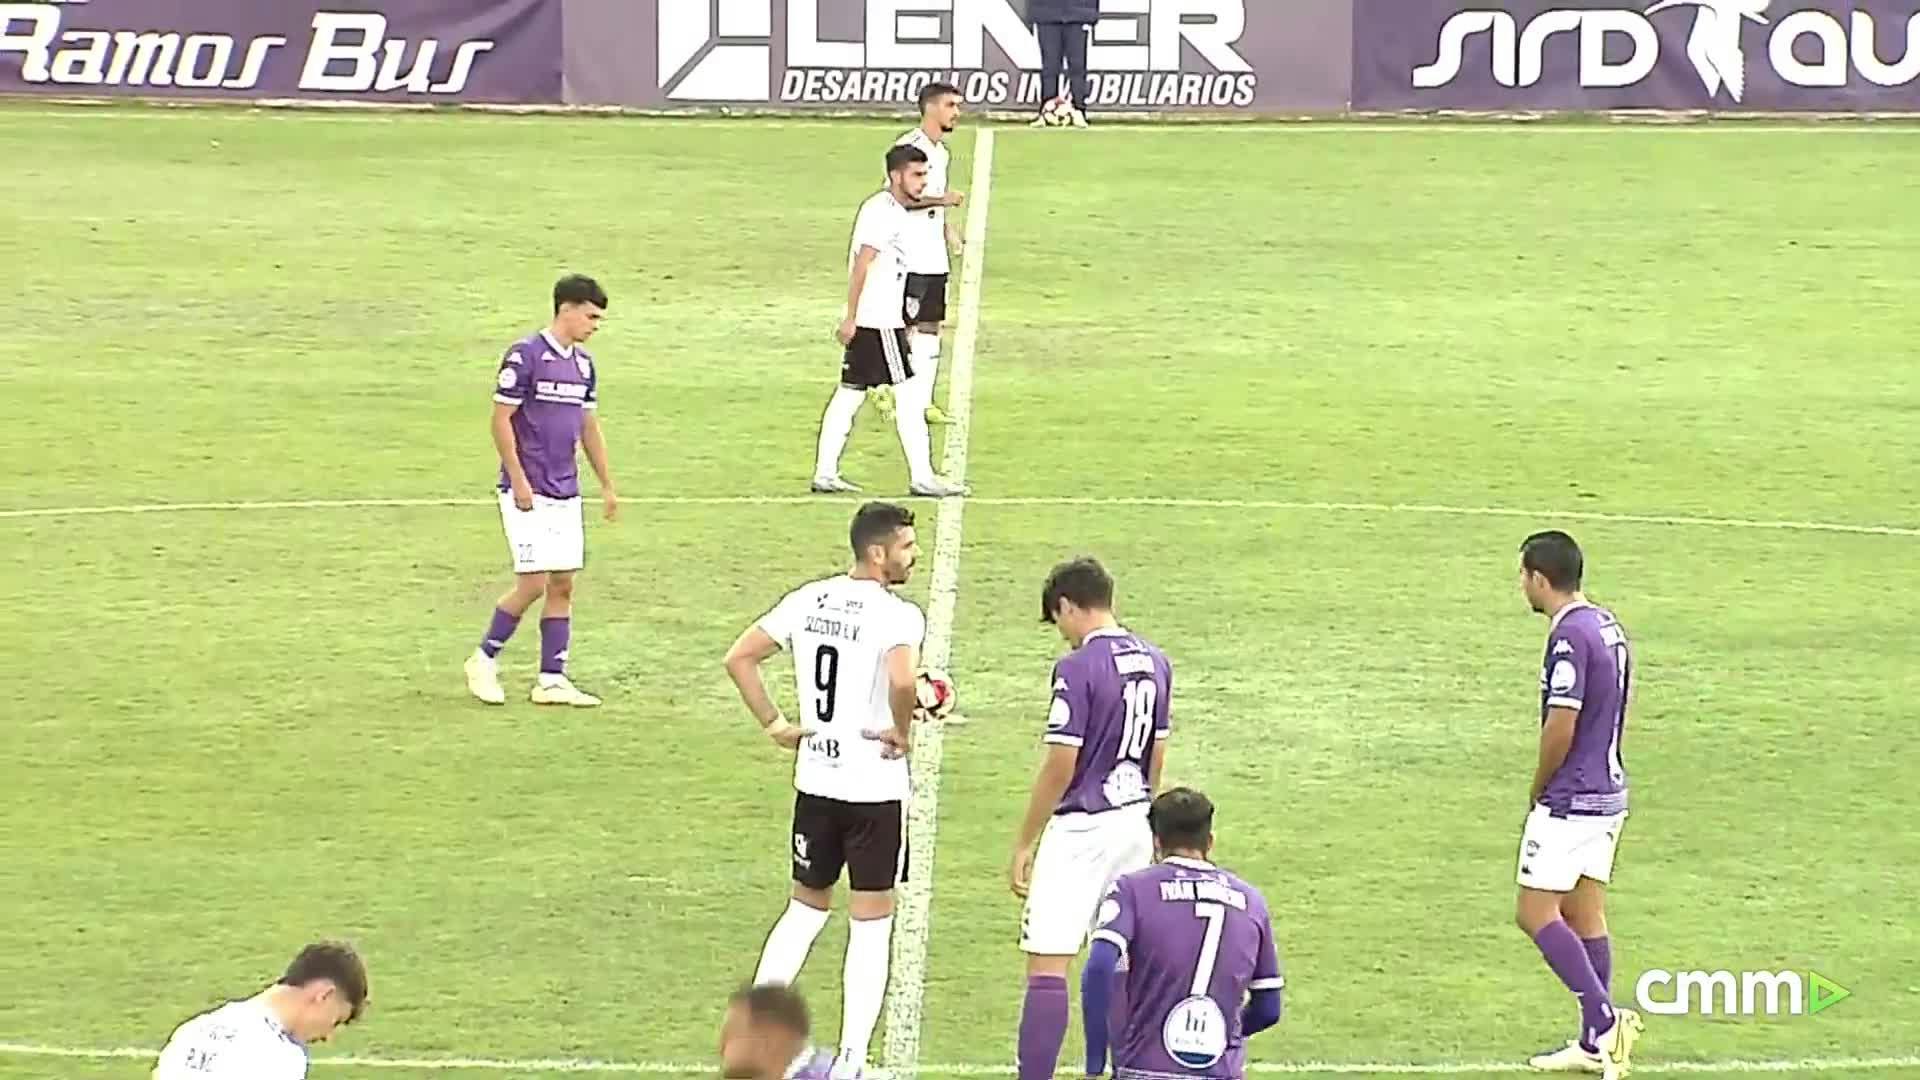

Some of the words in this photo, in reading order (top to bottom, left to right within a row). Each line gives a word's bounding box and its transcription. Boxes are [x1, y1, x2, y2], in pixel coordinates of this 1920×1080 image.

[0, 3, 286, 88] Ramos
[298, 11, 494, 94] Bus
[815, 644, 839, 722] 9
[1116, 679, 1157, 760] 18
[1190, 902, 1225, 996] 7
